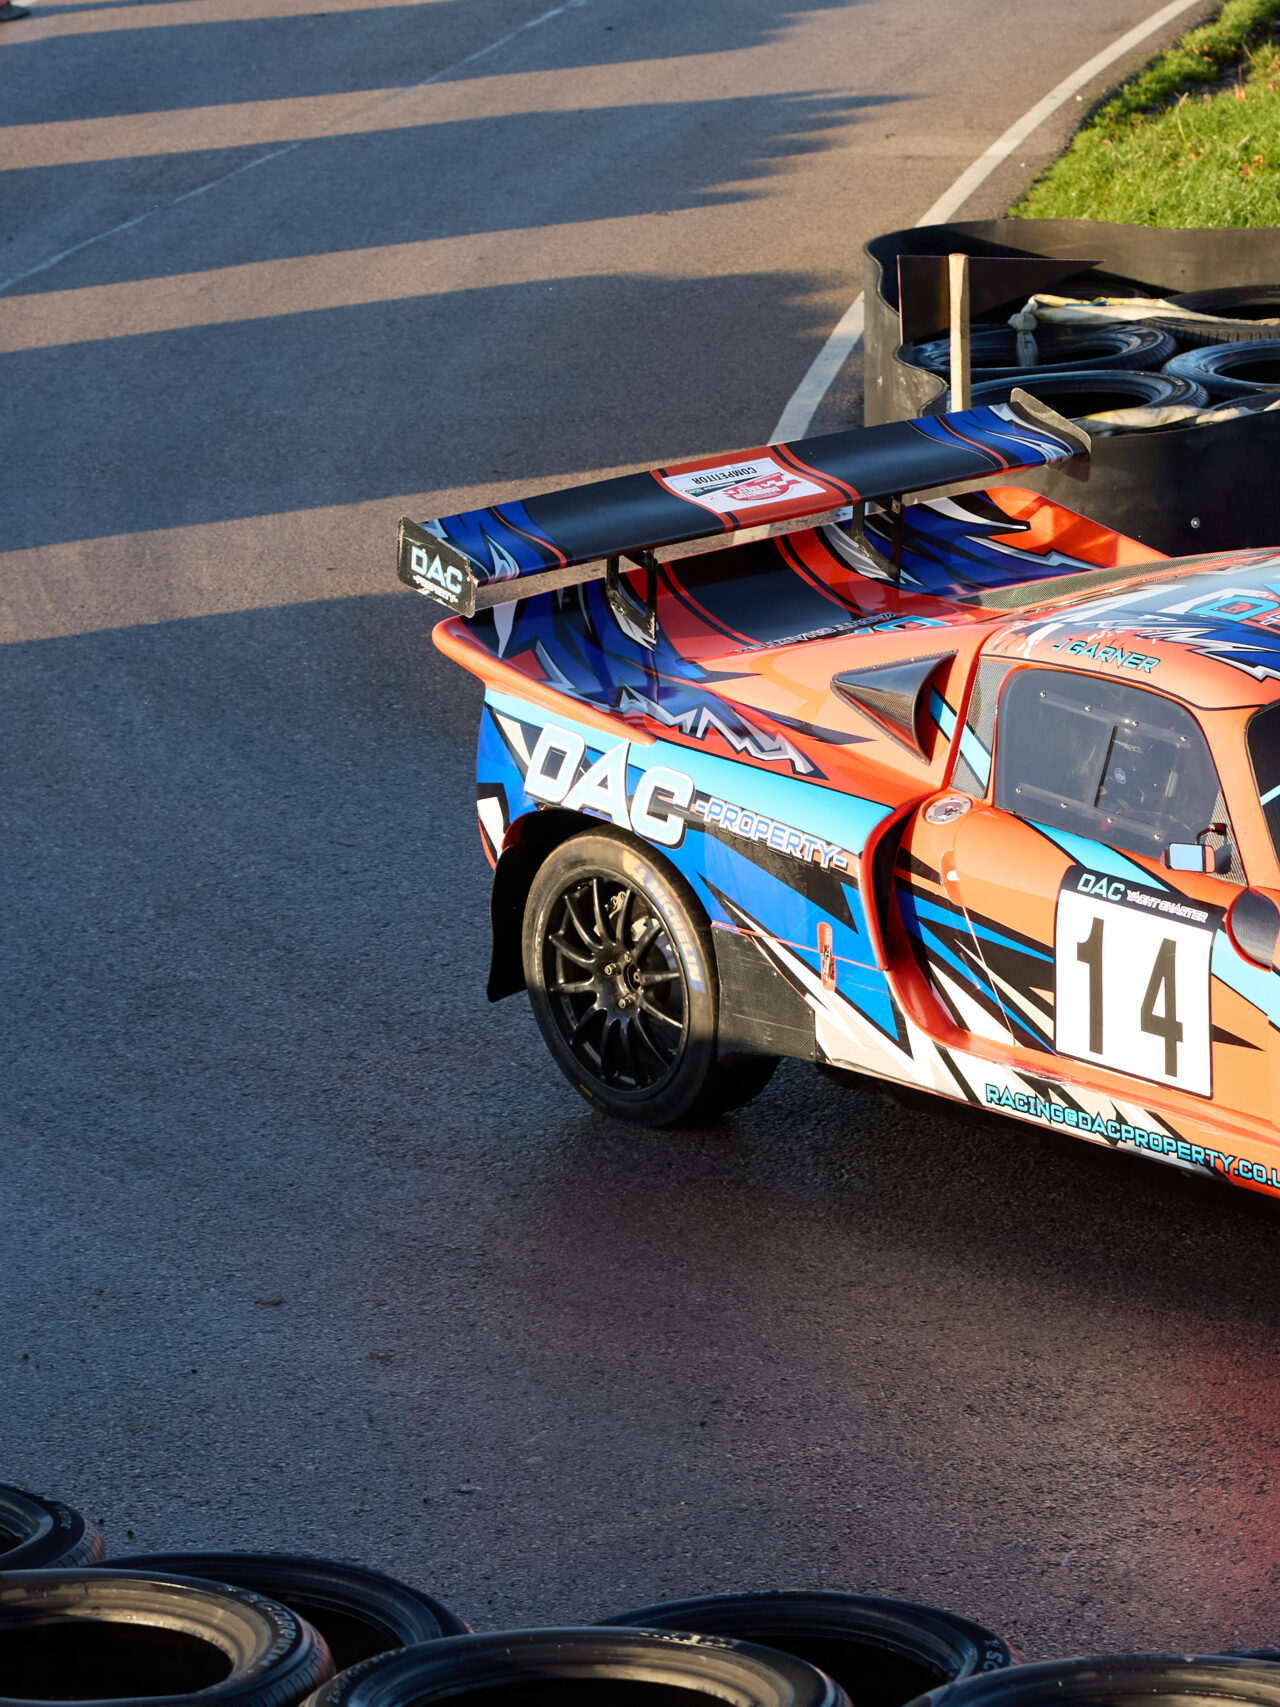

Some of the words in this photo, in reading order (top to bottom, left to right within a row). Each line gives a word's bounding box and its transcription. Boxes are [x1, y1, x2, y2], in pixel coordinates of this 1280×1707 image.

[691, 466, 758, 484] COMPETITOR
[411, 545, 463, 595] DAC
[1051, 638, 1071, 652] J
[1066, 641, 1162, 674] GARNER
[524, 722, 696, 848] DAC
[1077, 872, 1126, 902] DAC
[646, 880, 702, 983] MICHELIN
[1077, 916, 1184, 1078] 14
